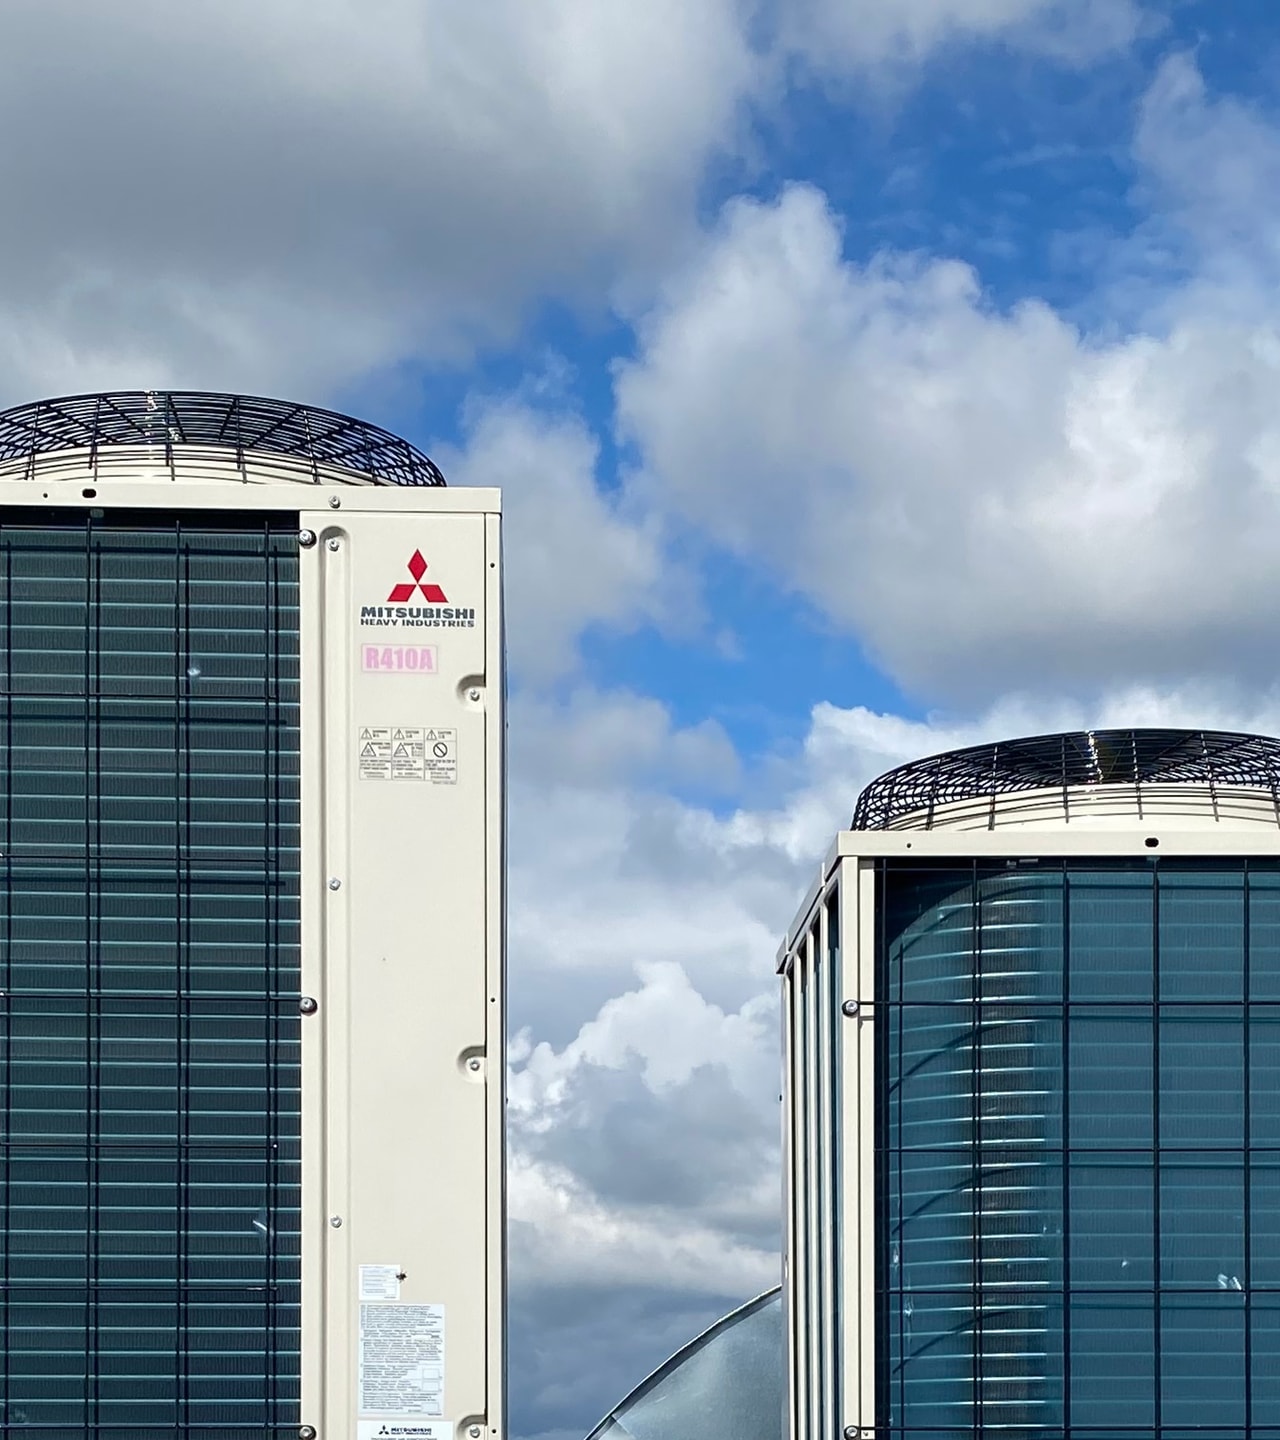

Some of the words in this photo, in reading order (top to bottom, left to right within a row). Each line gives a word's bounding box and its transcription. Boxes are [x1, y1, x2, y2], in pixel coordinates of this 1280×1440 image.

[361, 607, 475, 619] MITSUBISHI
[361, 618, 398, 626] HEAVY
[402, 619, 475, 628] INDUSTRIES
[366, 647, 433, 670] R410A
